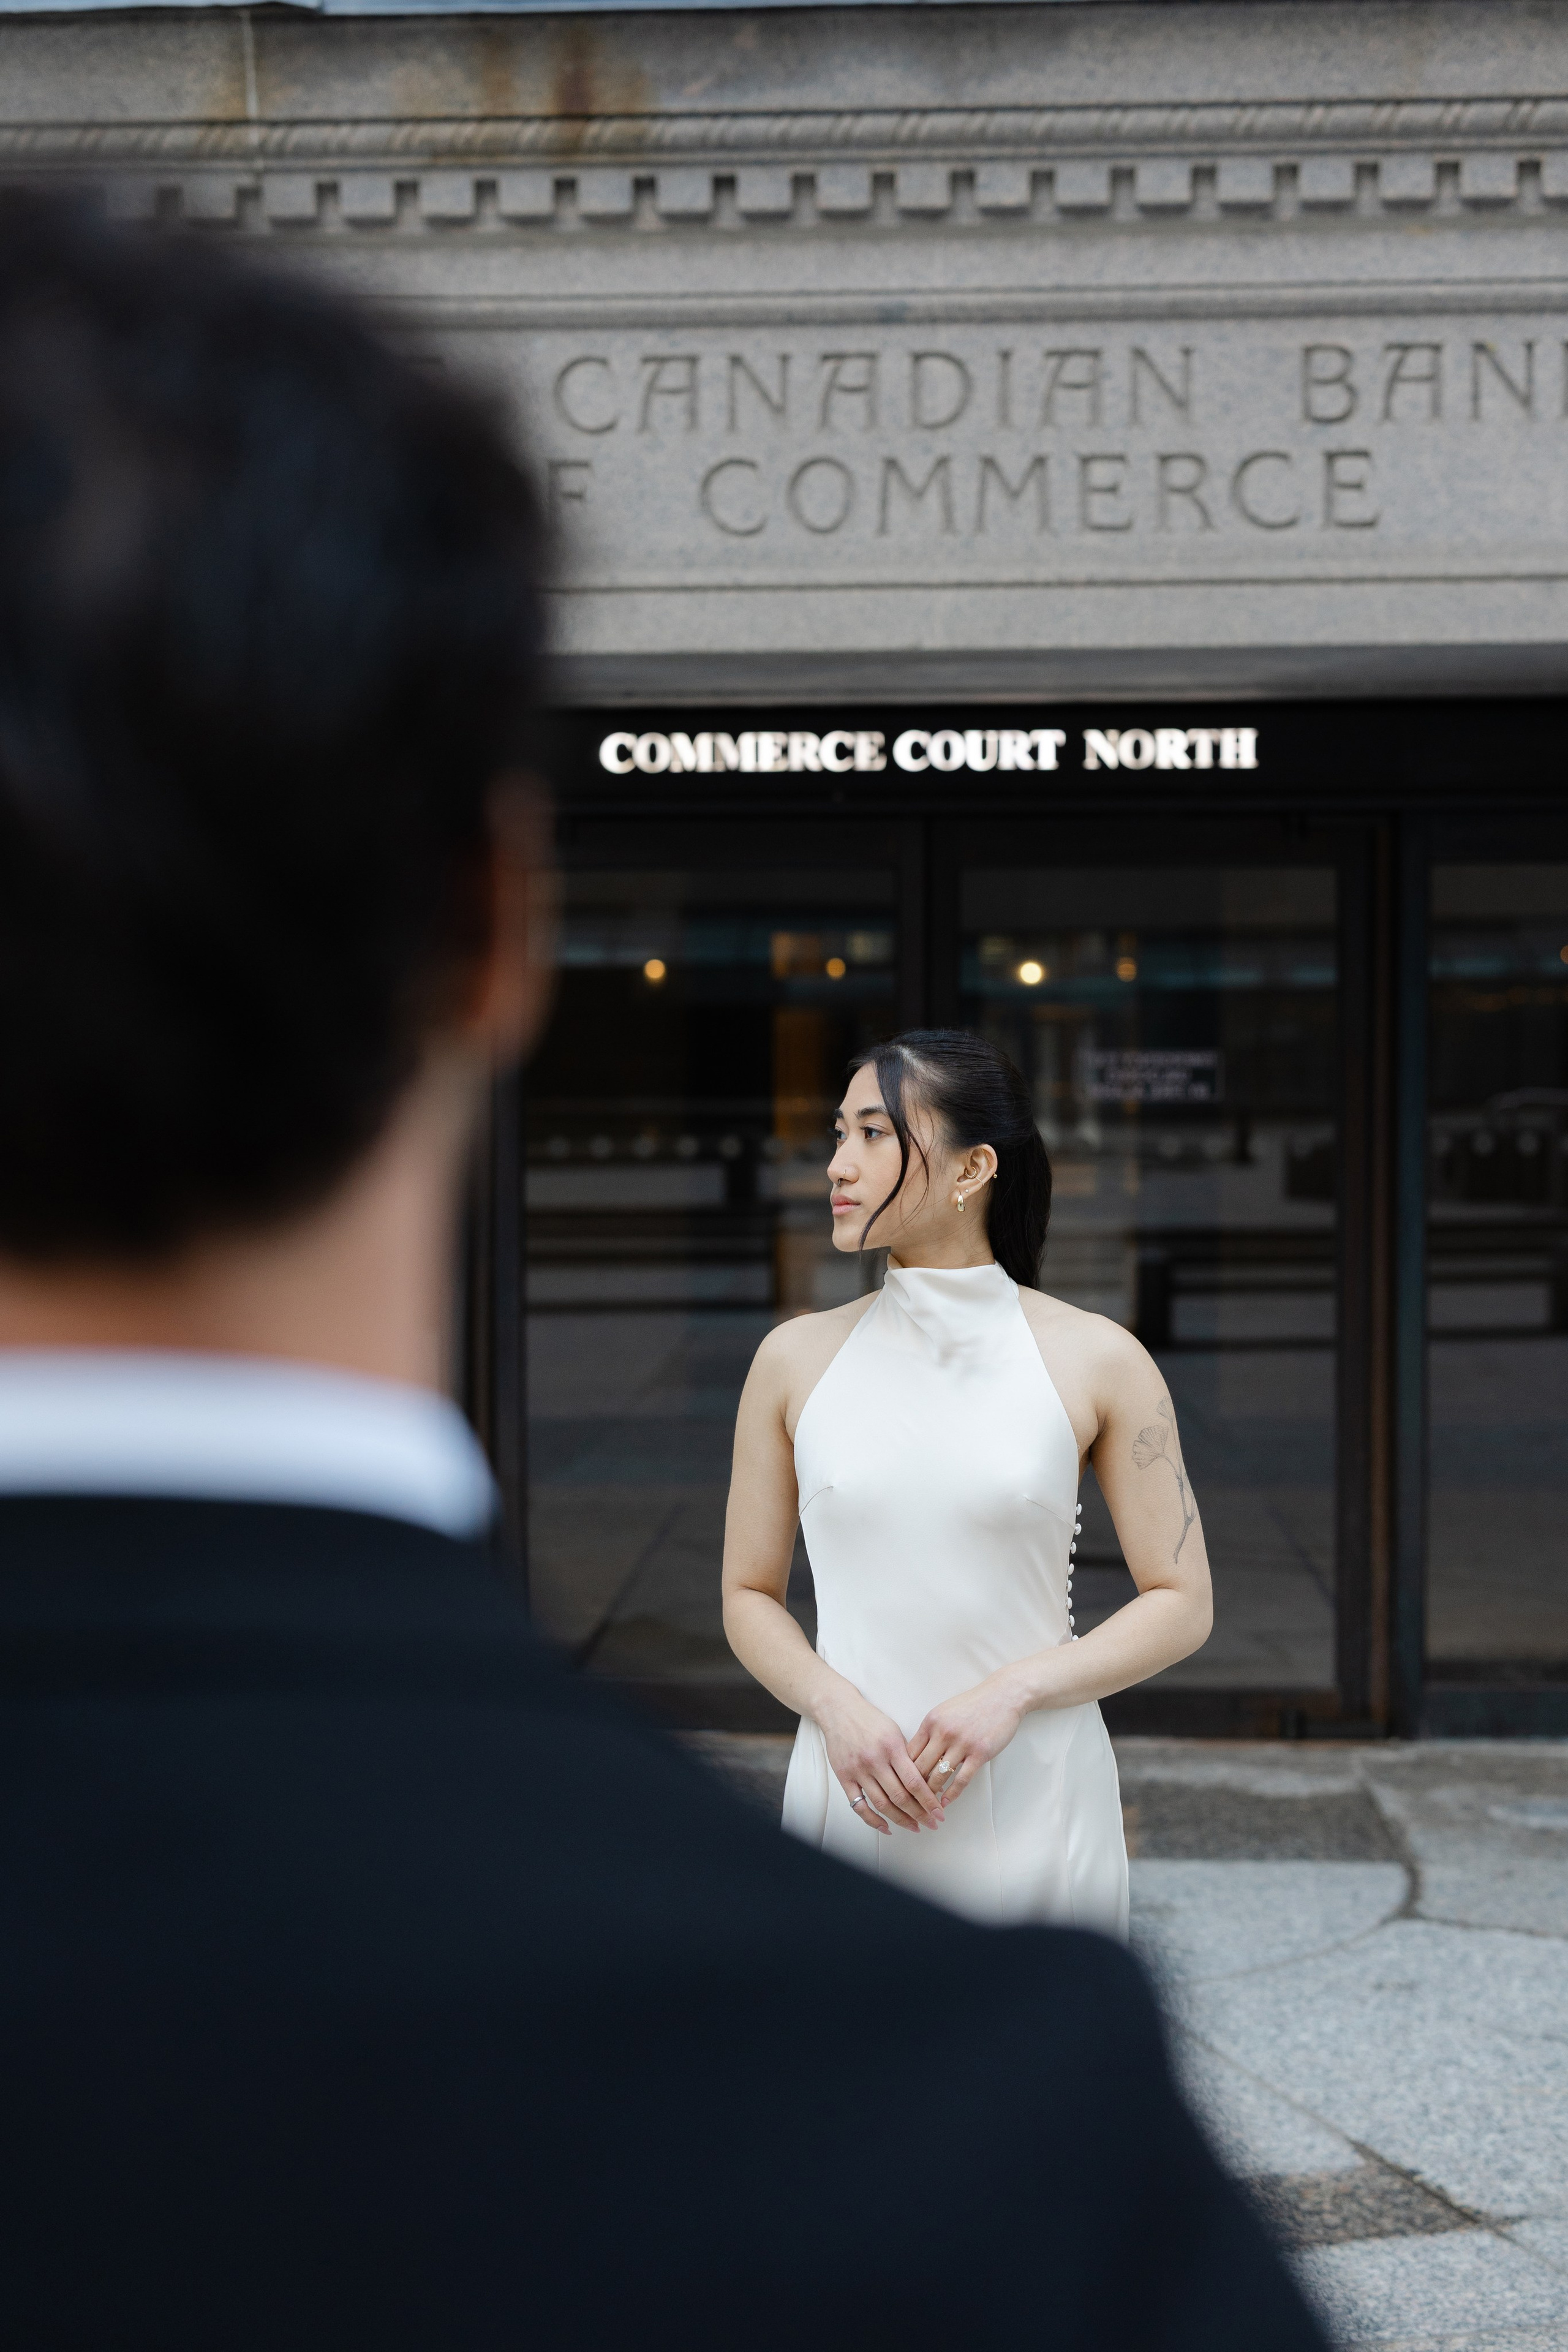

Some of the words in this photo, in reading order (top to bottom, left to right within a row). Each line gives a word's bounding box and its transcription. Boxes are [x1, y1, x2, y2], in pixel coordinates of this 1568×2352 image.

[554, 347, 1194, 435] CANADIAN
[1301, 339, 1568, 424] BAN
[700, 448, 1383, 537] COMMERCE
[598, 730, 887, 774] COMMERCE
[892, 729, 1066, 772] COURT
[1083, 727, 1257, 769] NORTH
